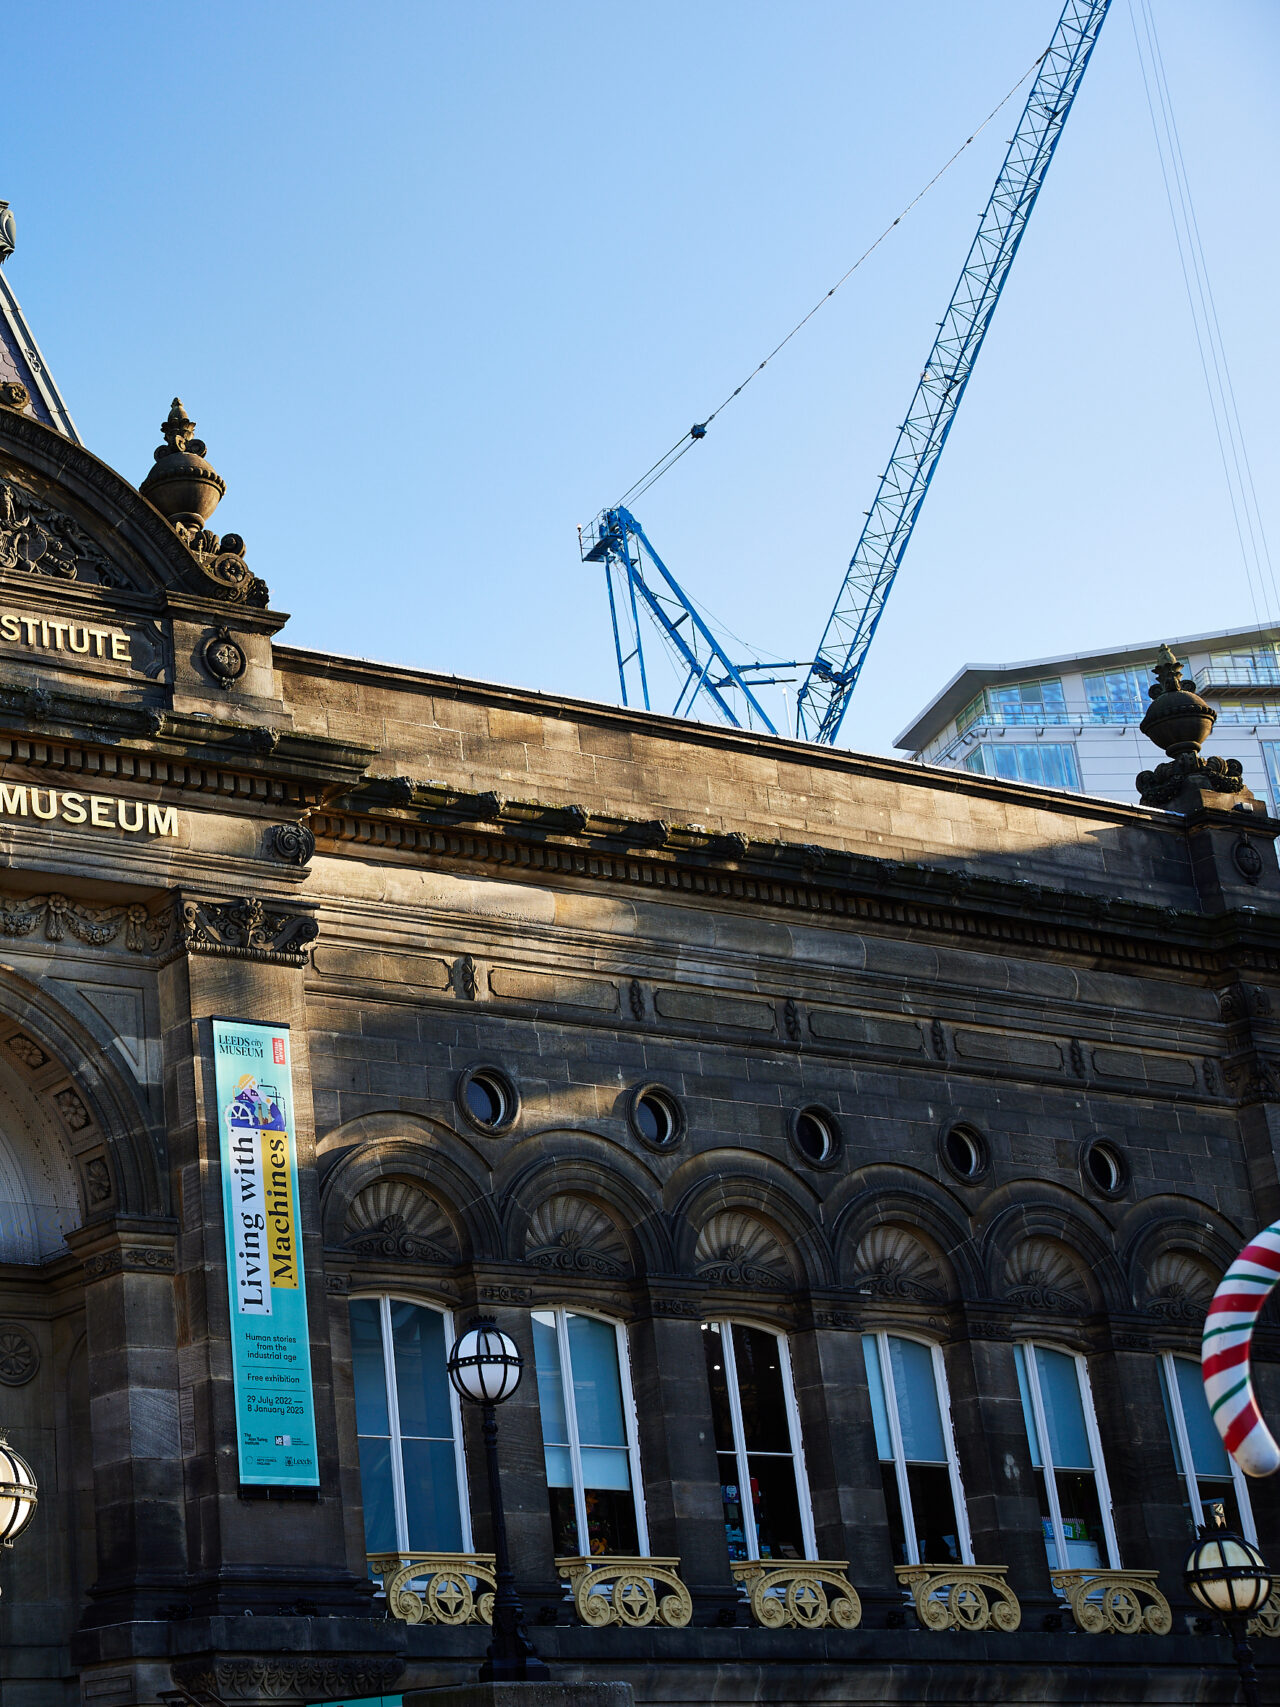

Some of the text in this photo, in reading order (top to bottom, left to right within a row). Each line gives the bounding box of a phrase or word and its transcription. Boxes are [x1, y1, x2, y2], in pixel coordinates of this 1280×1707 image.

[219, 1034, 264, 1048] LEEDS city
[219, 1044, 264, 1058] MUSEUM
[267, 1138, 293, 1280] Machines
[233, 1136, 264, 1306] Living with
[245, 1332, 297, 1344] Human stories
[256, 1342, 287, 1351] from the
[247, 1350, 297, 1363] industrial age
[247, 1372, 300, 1383] Free exhibition
[247, 1395, 256, 1403] 29
[258, 1395, 273, 1406] July
[275, 1396, 292, 1405] 2022
[247, 1404, 304, 1415] 8 January 2023
